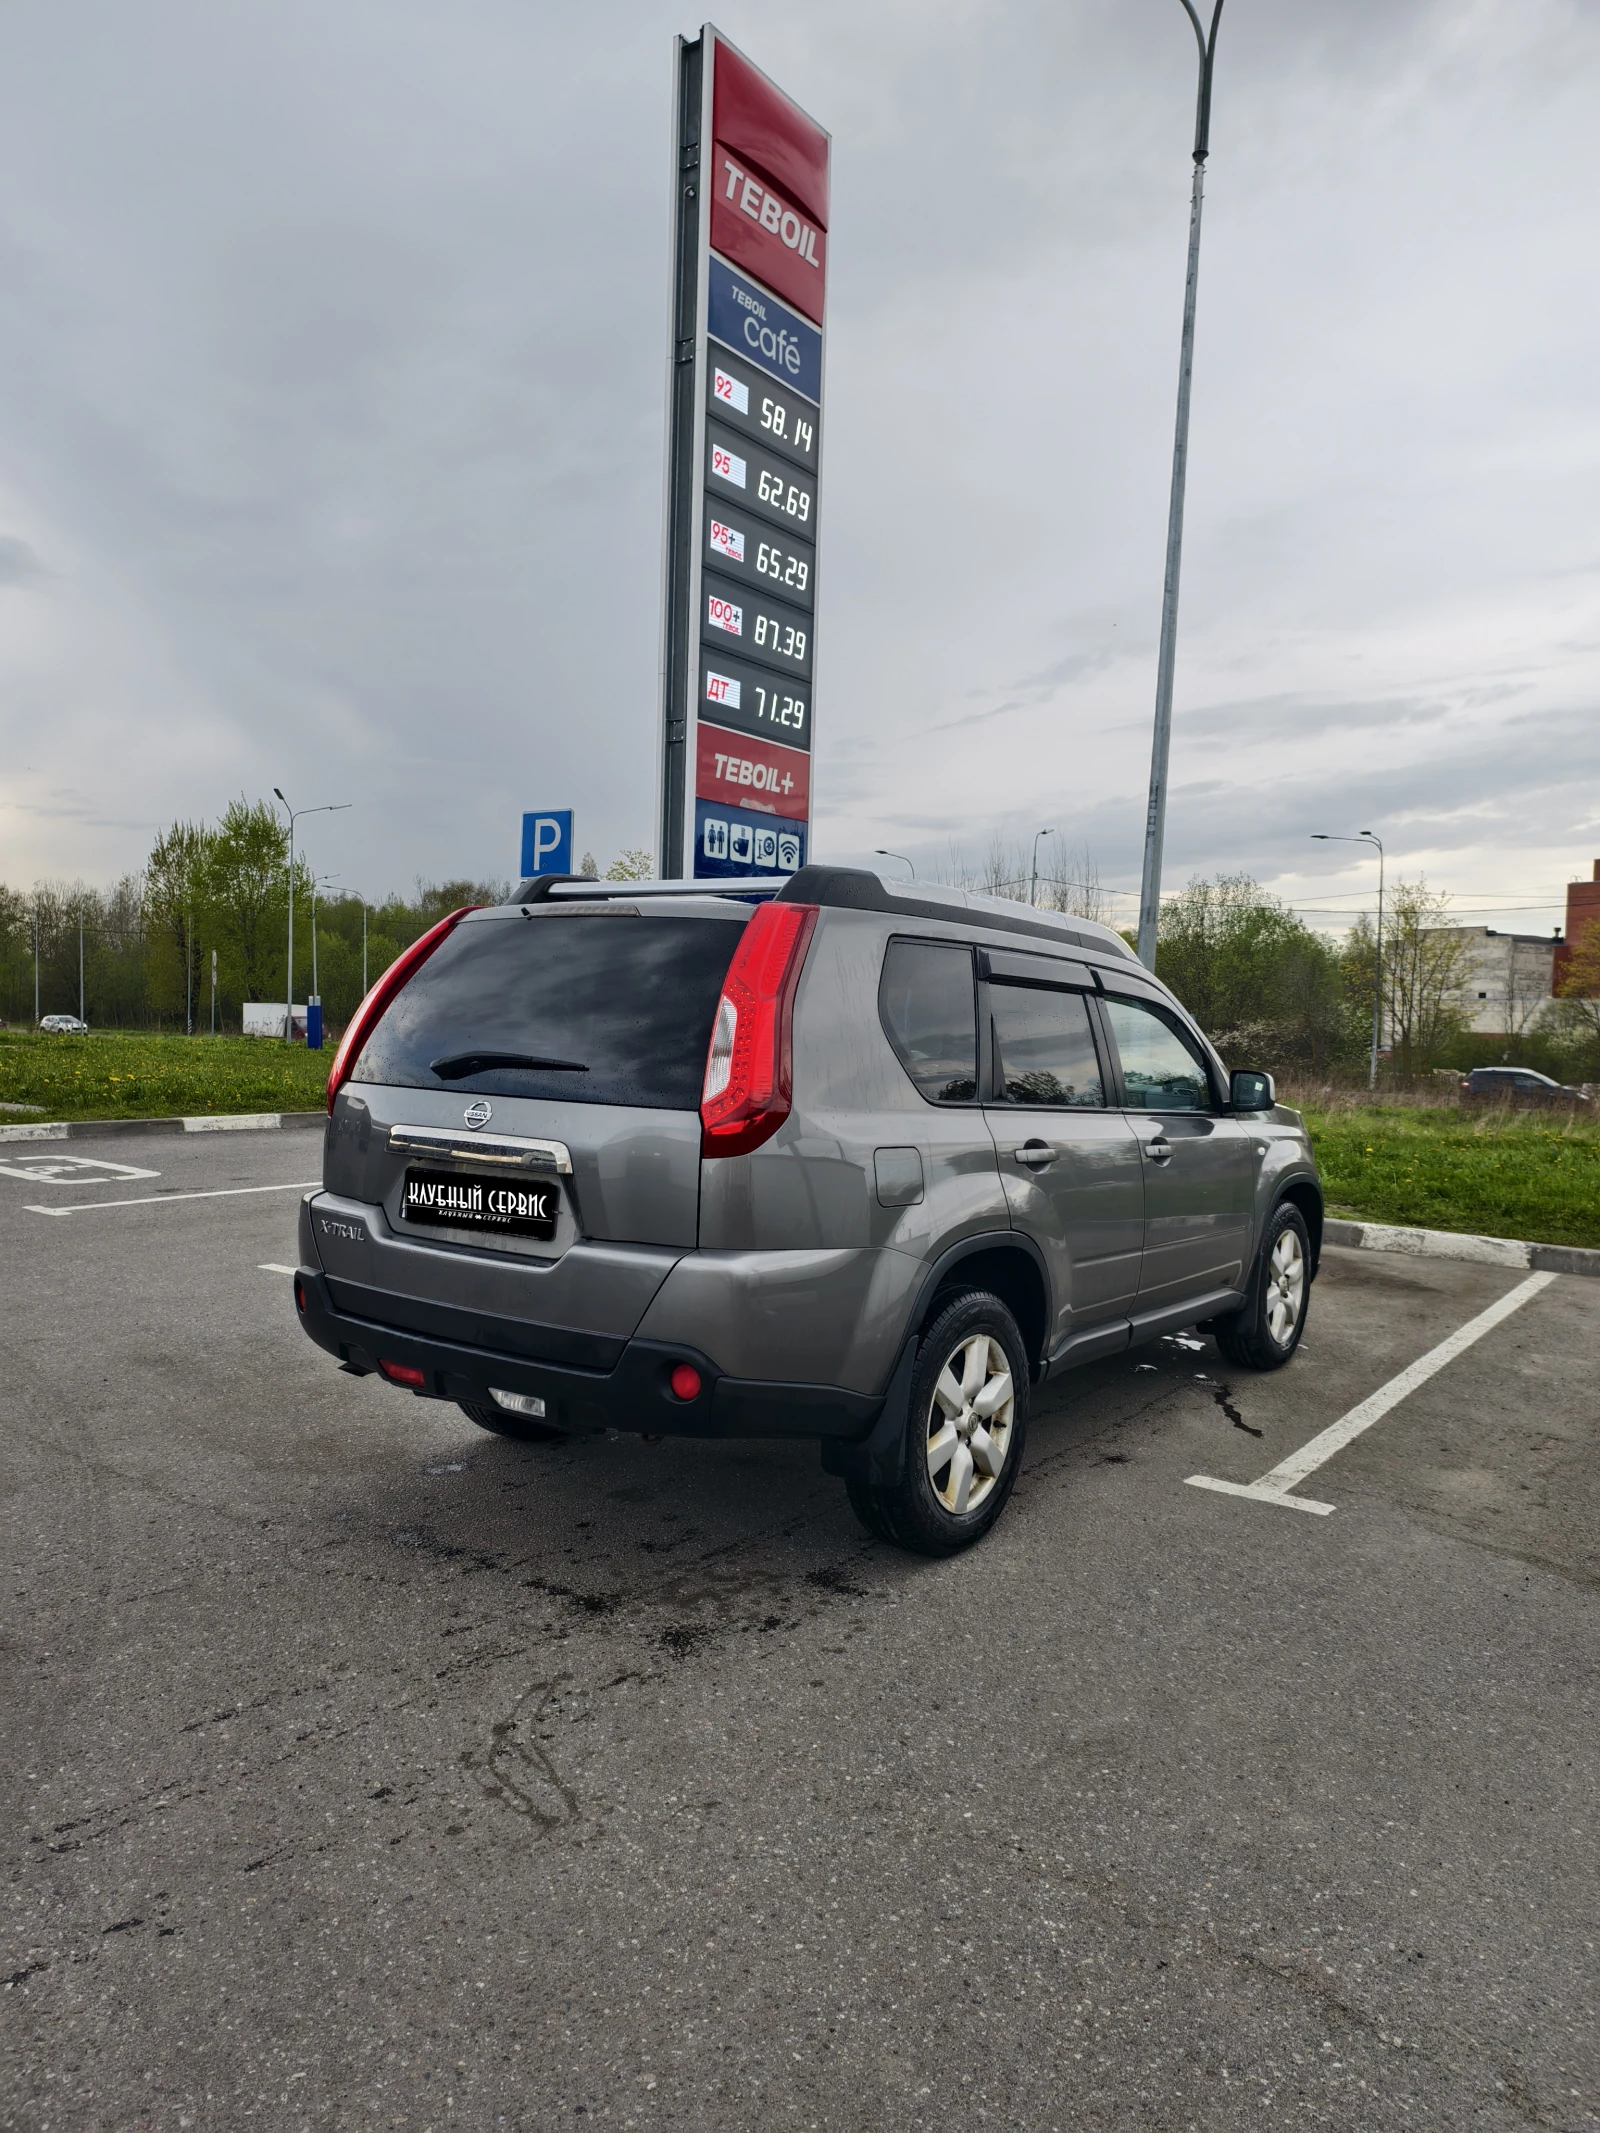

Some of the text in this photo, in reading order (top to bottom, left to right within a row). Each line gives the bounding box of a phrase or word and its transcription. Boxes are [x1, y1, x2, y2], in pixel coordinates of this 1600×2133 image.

[723, 160, 820, 269] TEBOIL
[731, 285, 767, 321] TEBOIL
[715, 375, 733, 399] 92
[713, 451, 731, 474] 95
[758, 470, 811, 522] 62.69
[712, 522, 736, 545] 95+
[756, 542, 809, 591] 65.29
[709, 598, 740, 623] 100+
[754, 614, 807, 661] 87.39
[707, 678, 729, 701] ДТ
[755, 686, 805, 730] 71.29
[714, 752, 794, 795] TEBOIL+
[533, 818, 562, 871] P
[466, 1111, 488, 1119] NISSAN
[320, 1219, 365, 1242] X-TRAIL
